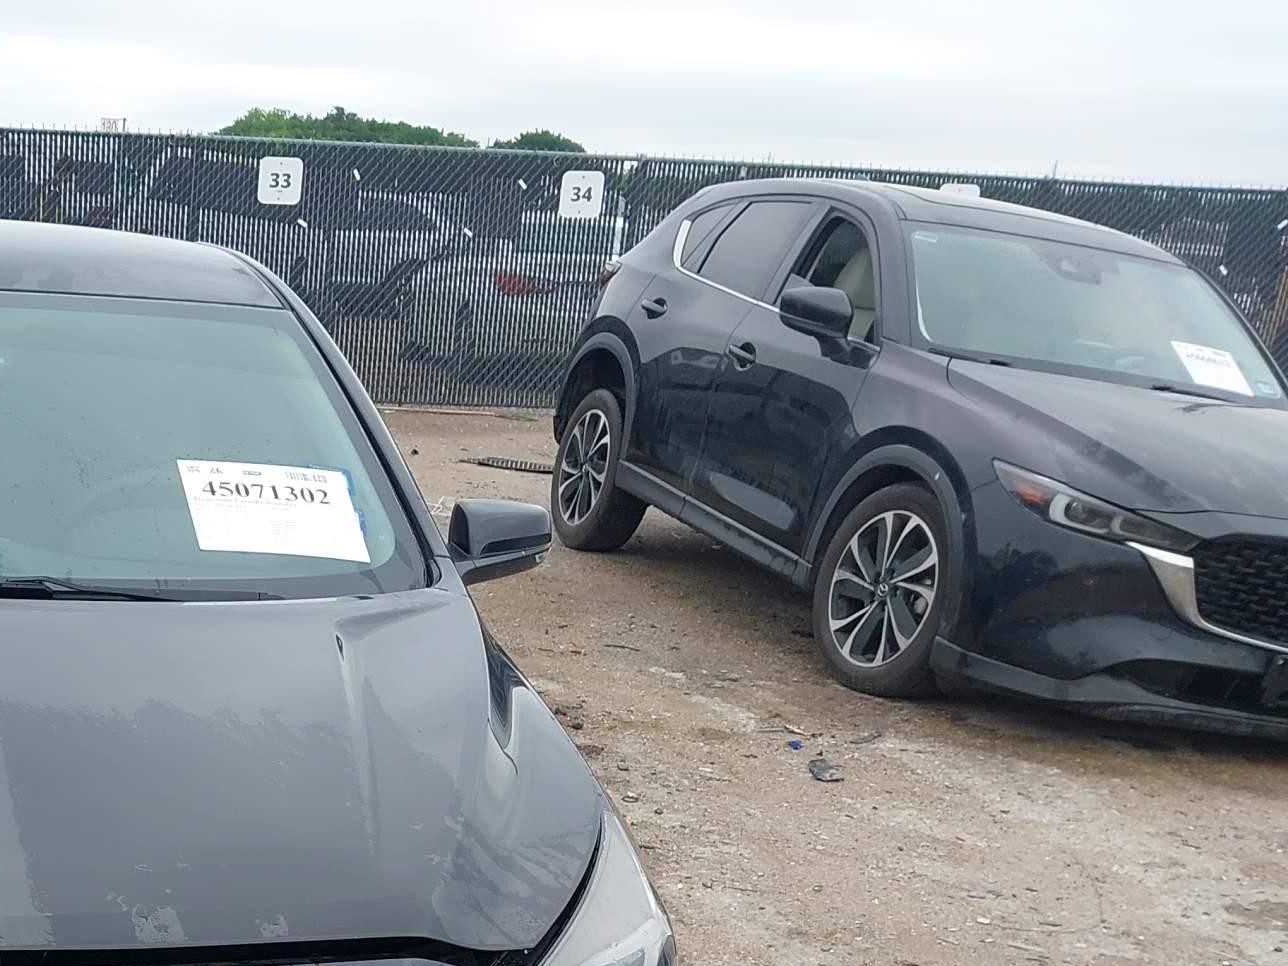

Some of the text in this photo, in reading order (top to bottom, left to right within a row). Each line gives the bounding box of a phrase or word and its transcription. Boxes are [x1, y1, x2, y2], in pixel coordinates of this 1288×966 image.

[269, 173, 292, 188] 33
[570, 186, 593, 202] 34
[201, 481, 332, 505] 45071302
